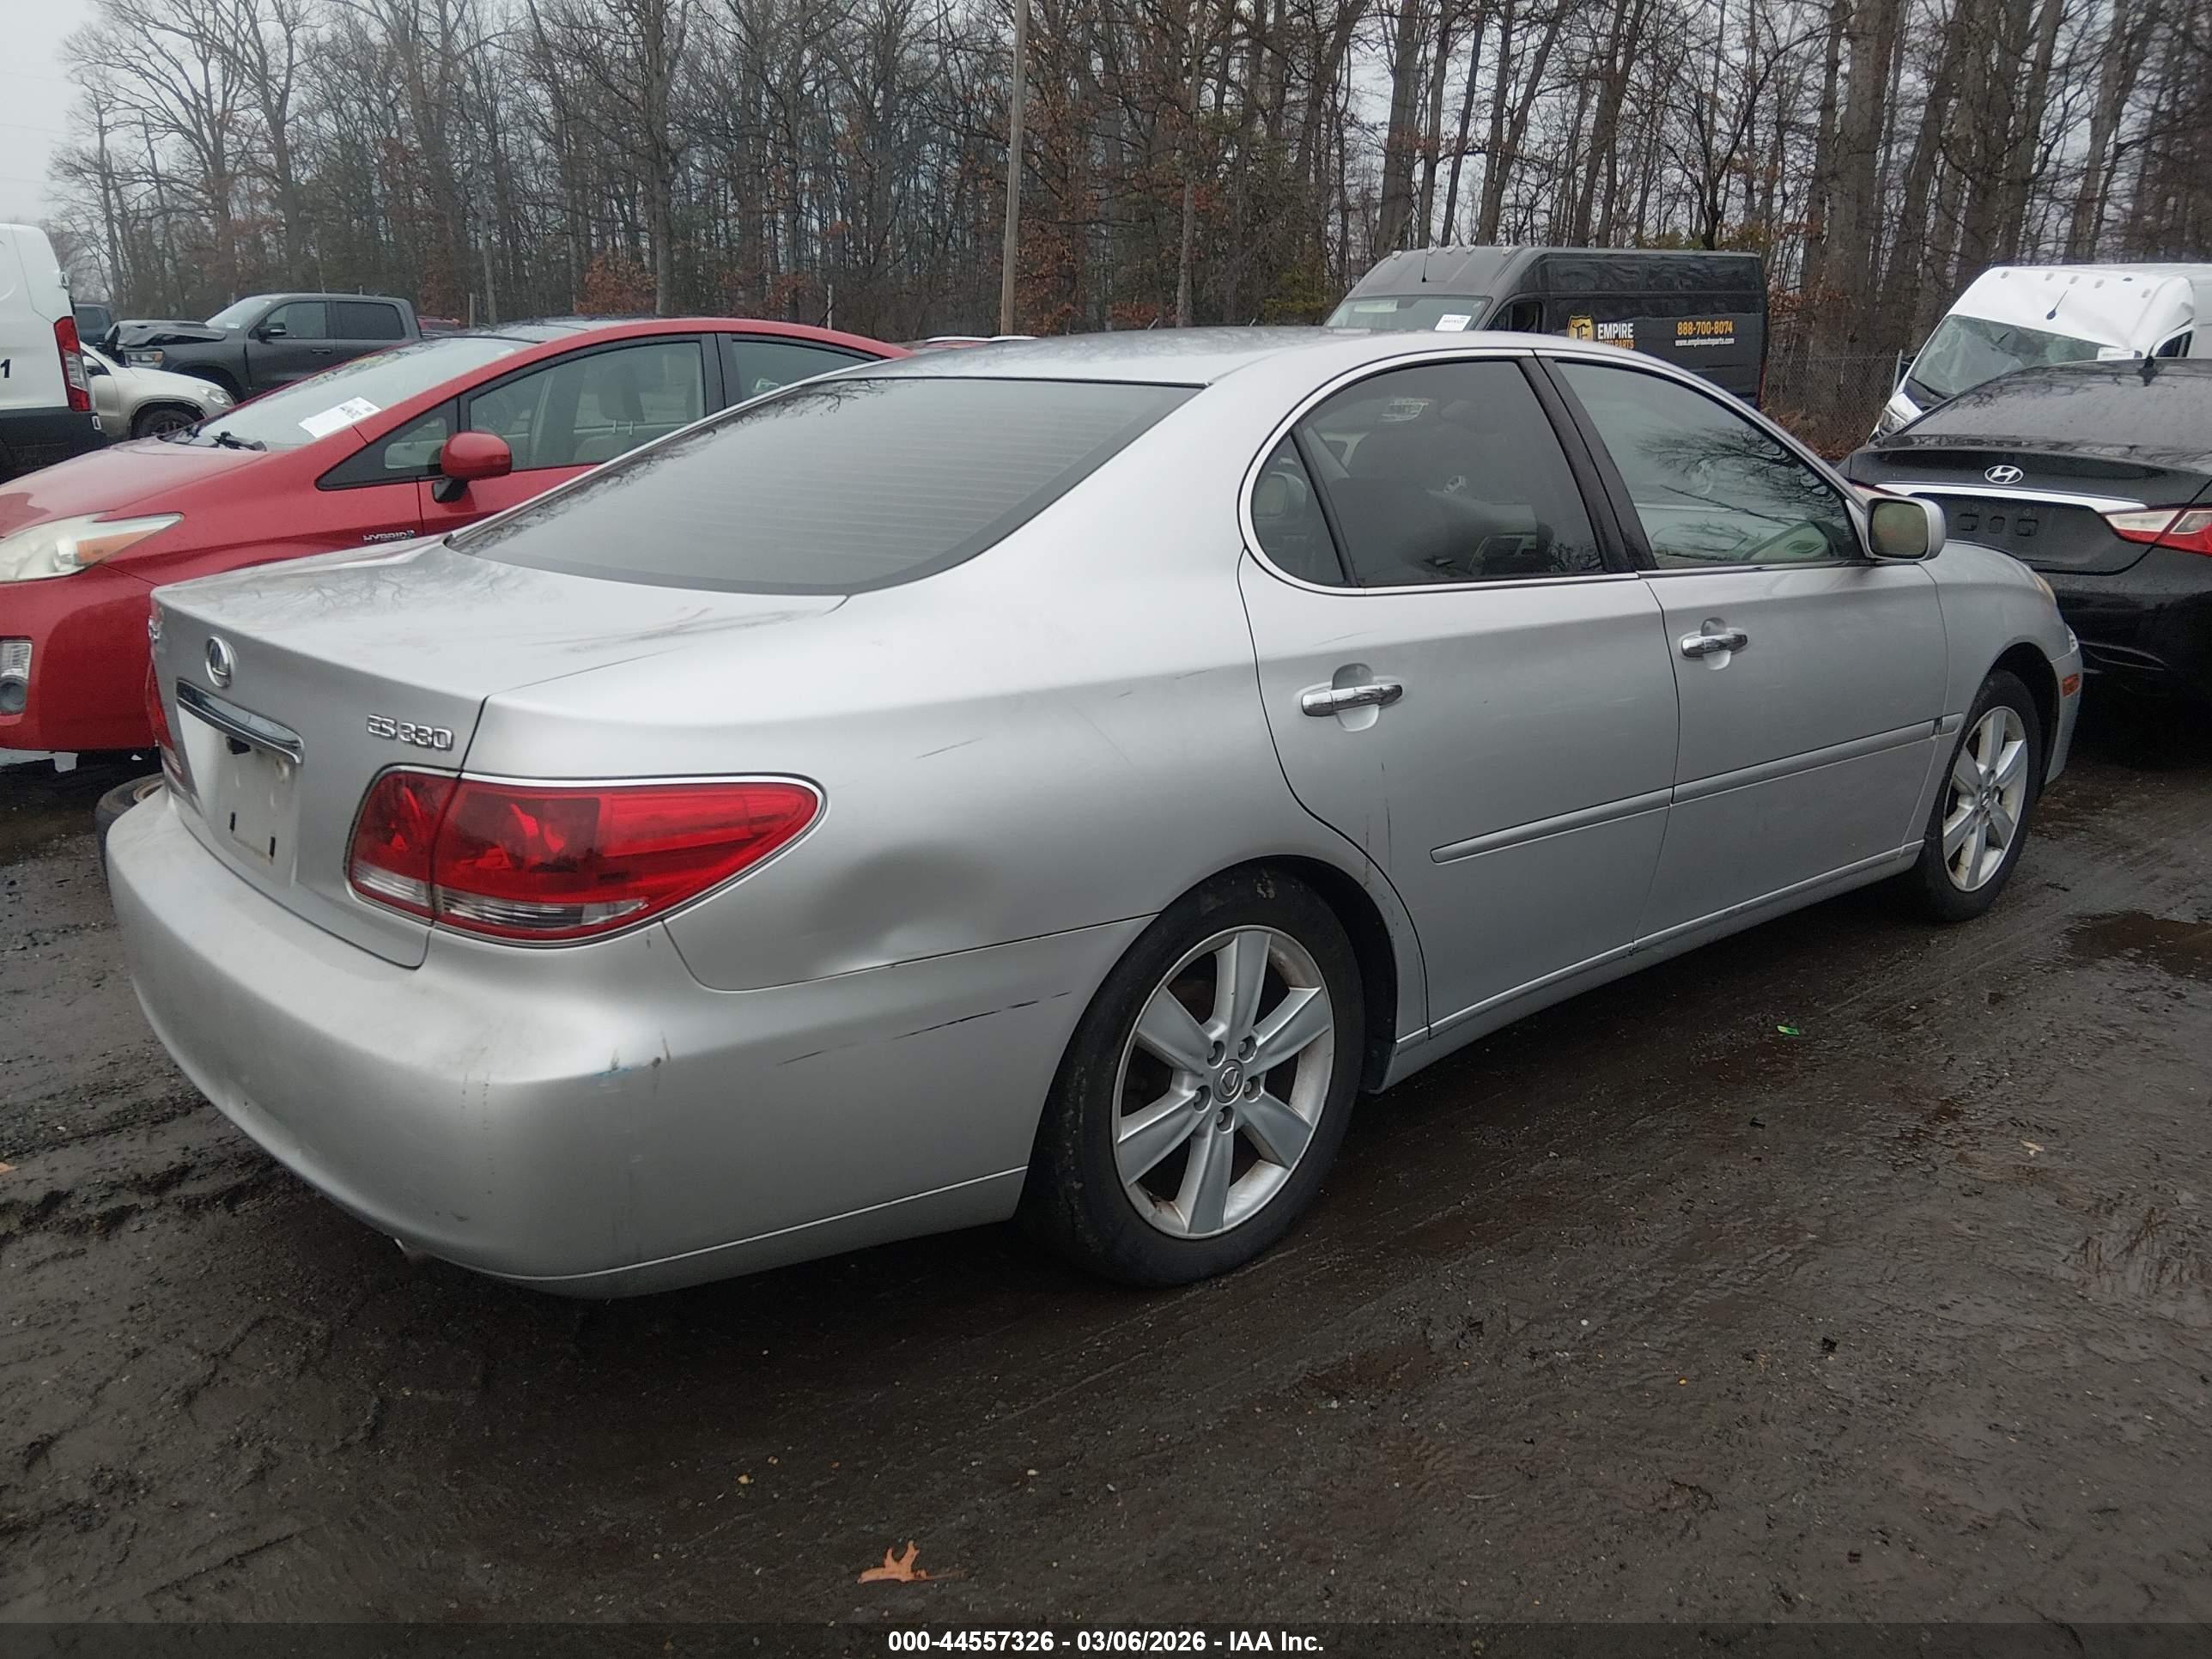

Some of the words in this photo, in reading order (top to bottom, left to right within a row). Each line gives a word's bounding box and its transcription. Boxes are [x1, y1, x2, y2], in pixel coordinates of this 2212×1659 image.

[1597, 322, 1634, 339] EMPIRE
[1677, 320, 1733, 336] 888-700-8074
[362, 531, 407, 541] HYBRID
[367, 714, 397, 738] ES
[398, 722, 453, 750] 330
